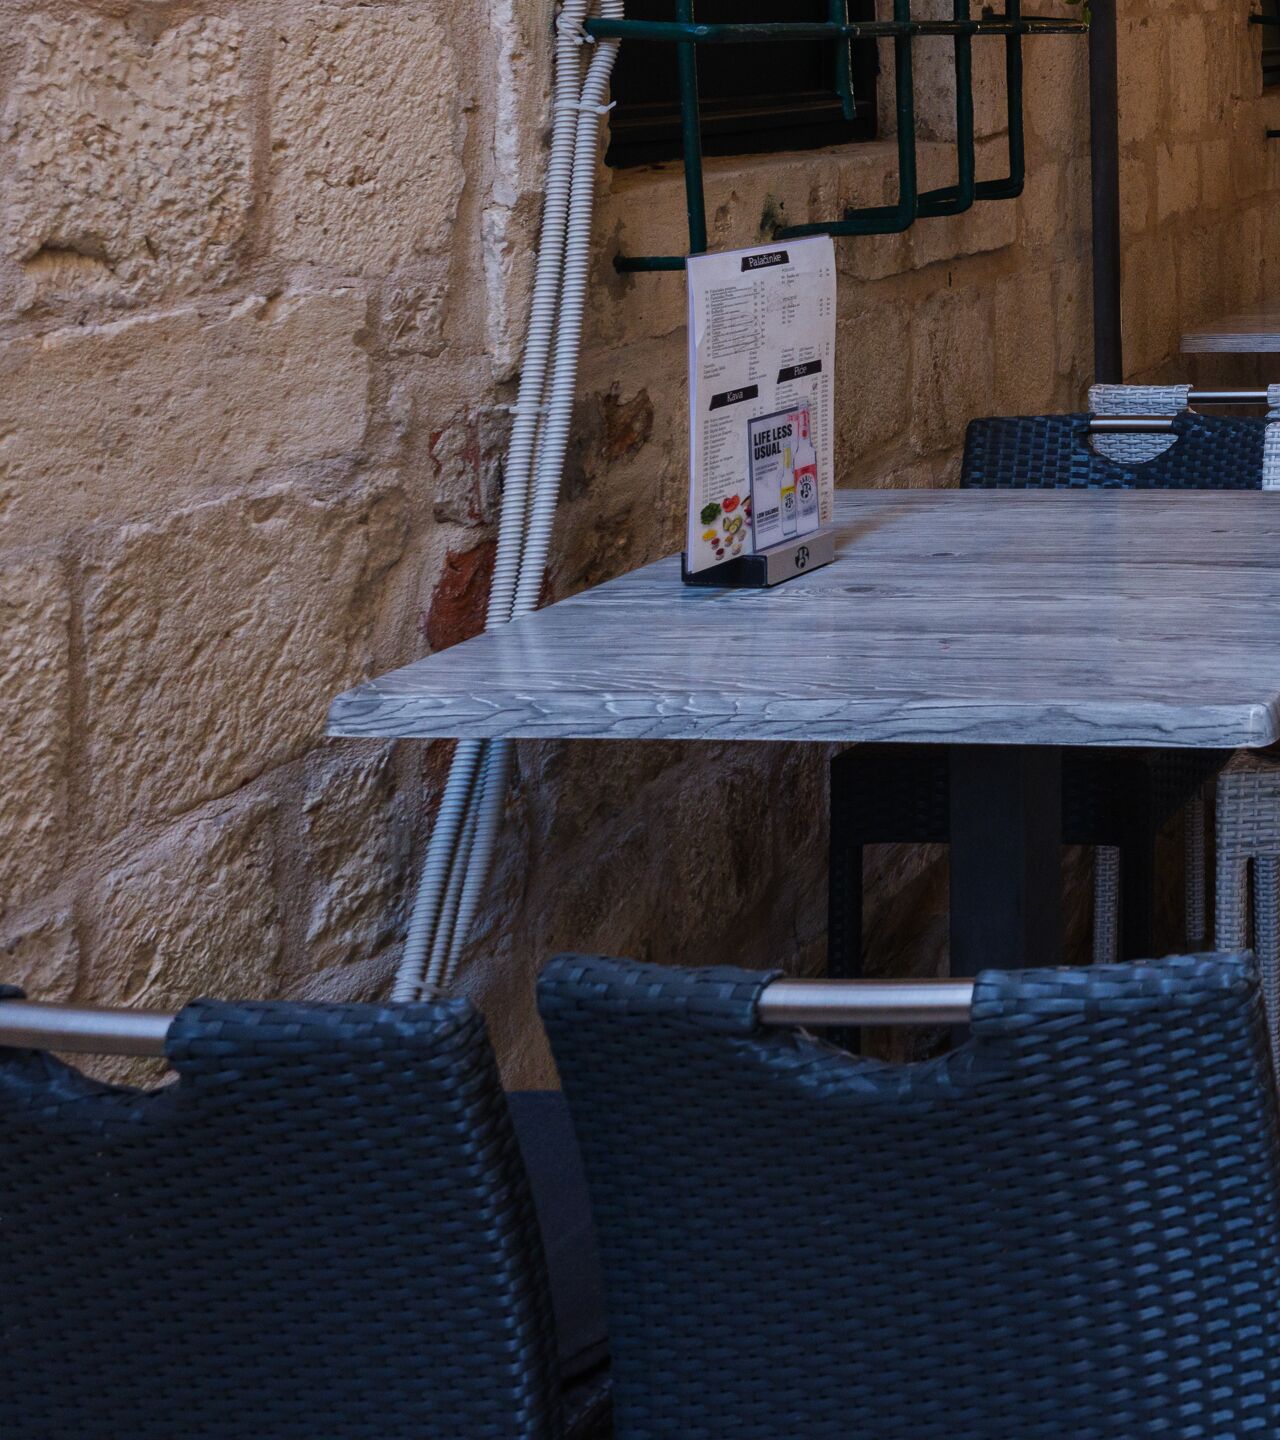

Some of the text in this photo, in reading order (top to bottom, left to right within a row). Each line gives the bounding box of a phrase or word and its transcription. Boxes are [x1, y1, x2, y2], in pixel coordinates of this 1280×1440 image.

[727, 390, 744, 402] Kava
[753, 423, 793, 447] LIFE LESS
[754, 441, 782, 461] USUAL
